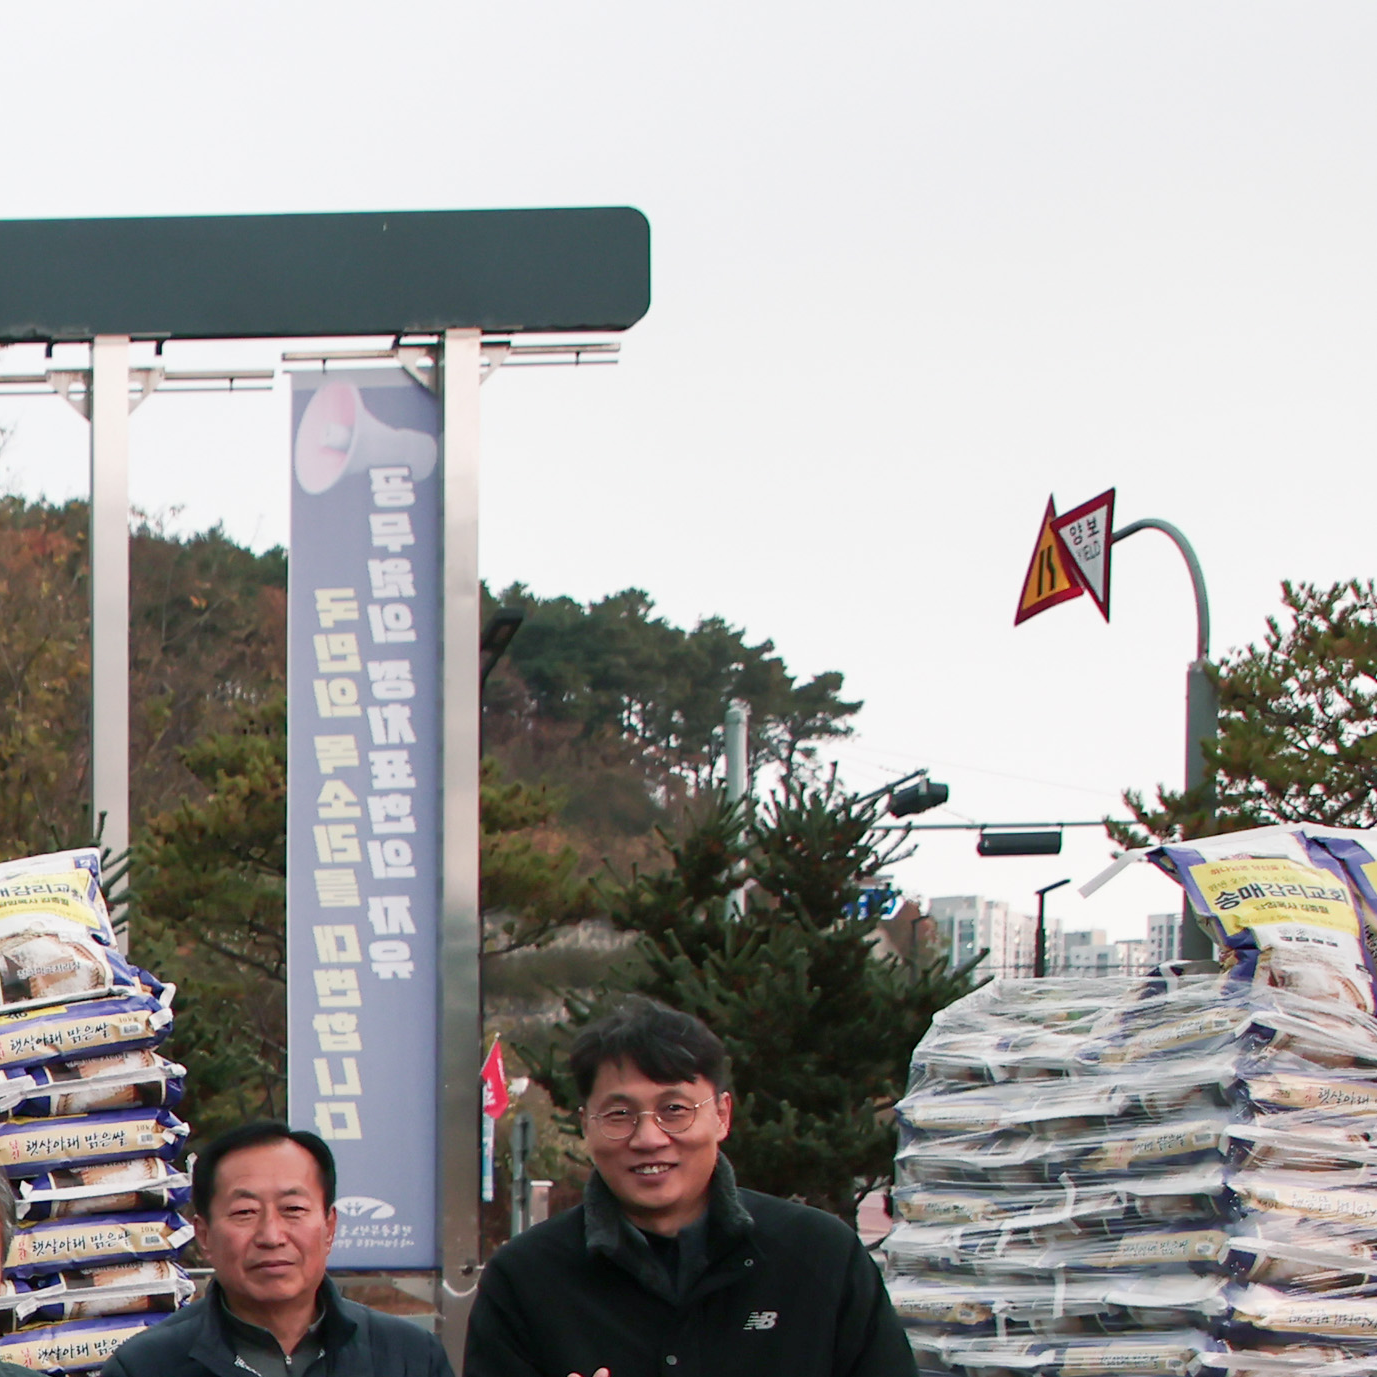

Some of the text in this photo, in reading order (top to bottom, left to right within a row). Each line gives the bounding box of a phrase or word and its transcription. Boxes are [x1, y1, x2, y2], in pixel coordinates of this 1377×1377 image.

[1214, 883, 1350, 911] 송매감리교회
[10, 1022, 110, 1054] 햇살아래 맑은쌀
[26, 1134, 80, 1157] 햇살아래
[84, 1130, 128, 1149] 맑은쌀
[32, 1229, 133, 1256] 햇살아래 맑은쌀
[37, 1338, 124, 1363] 햇살아래 맑은
